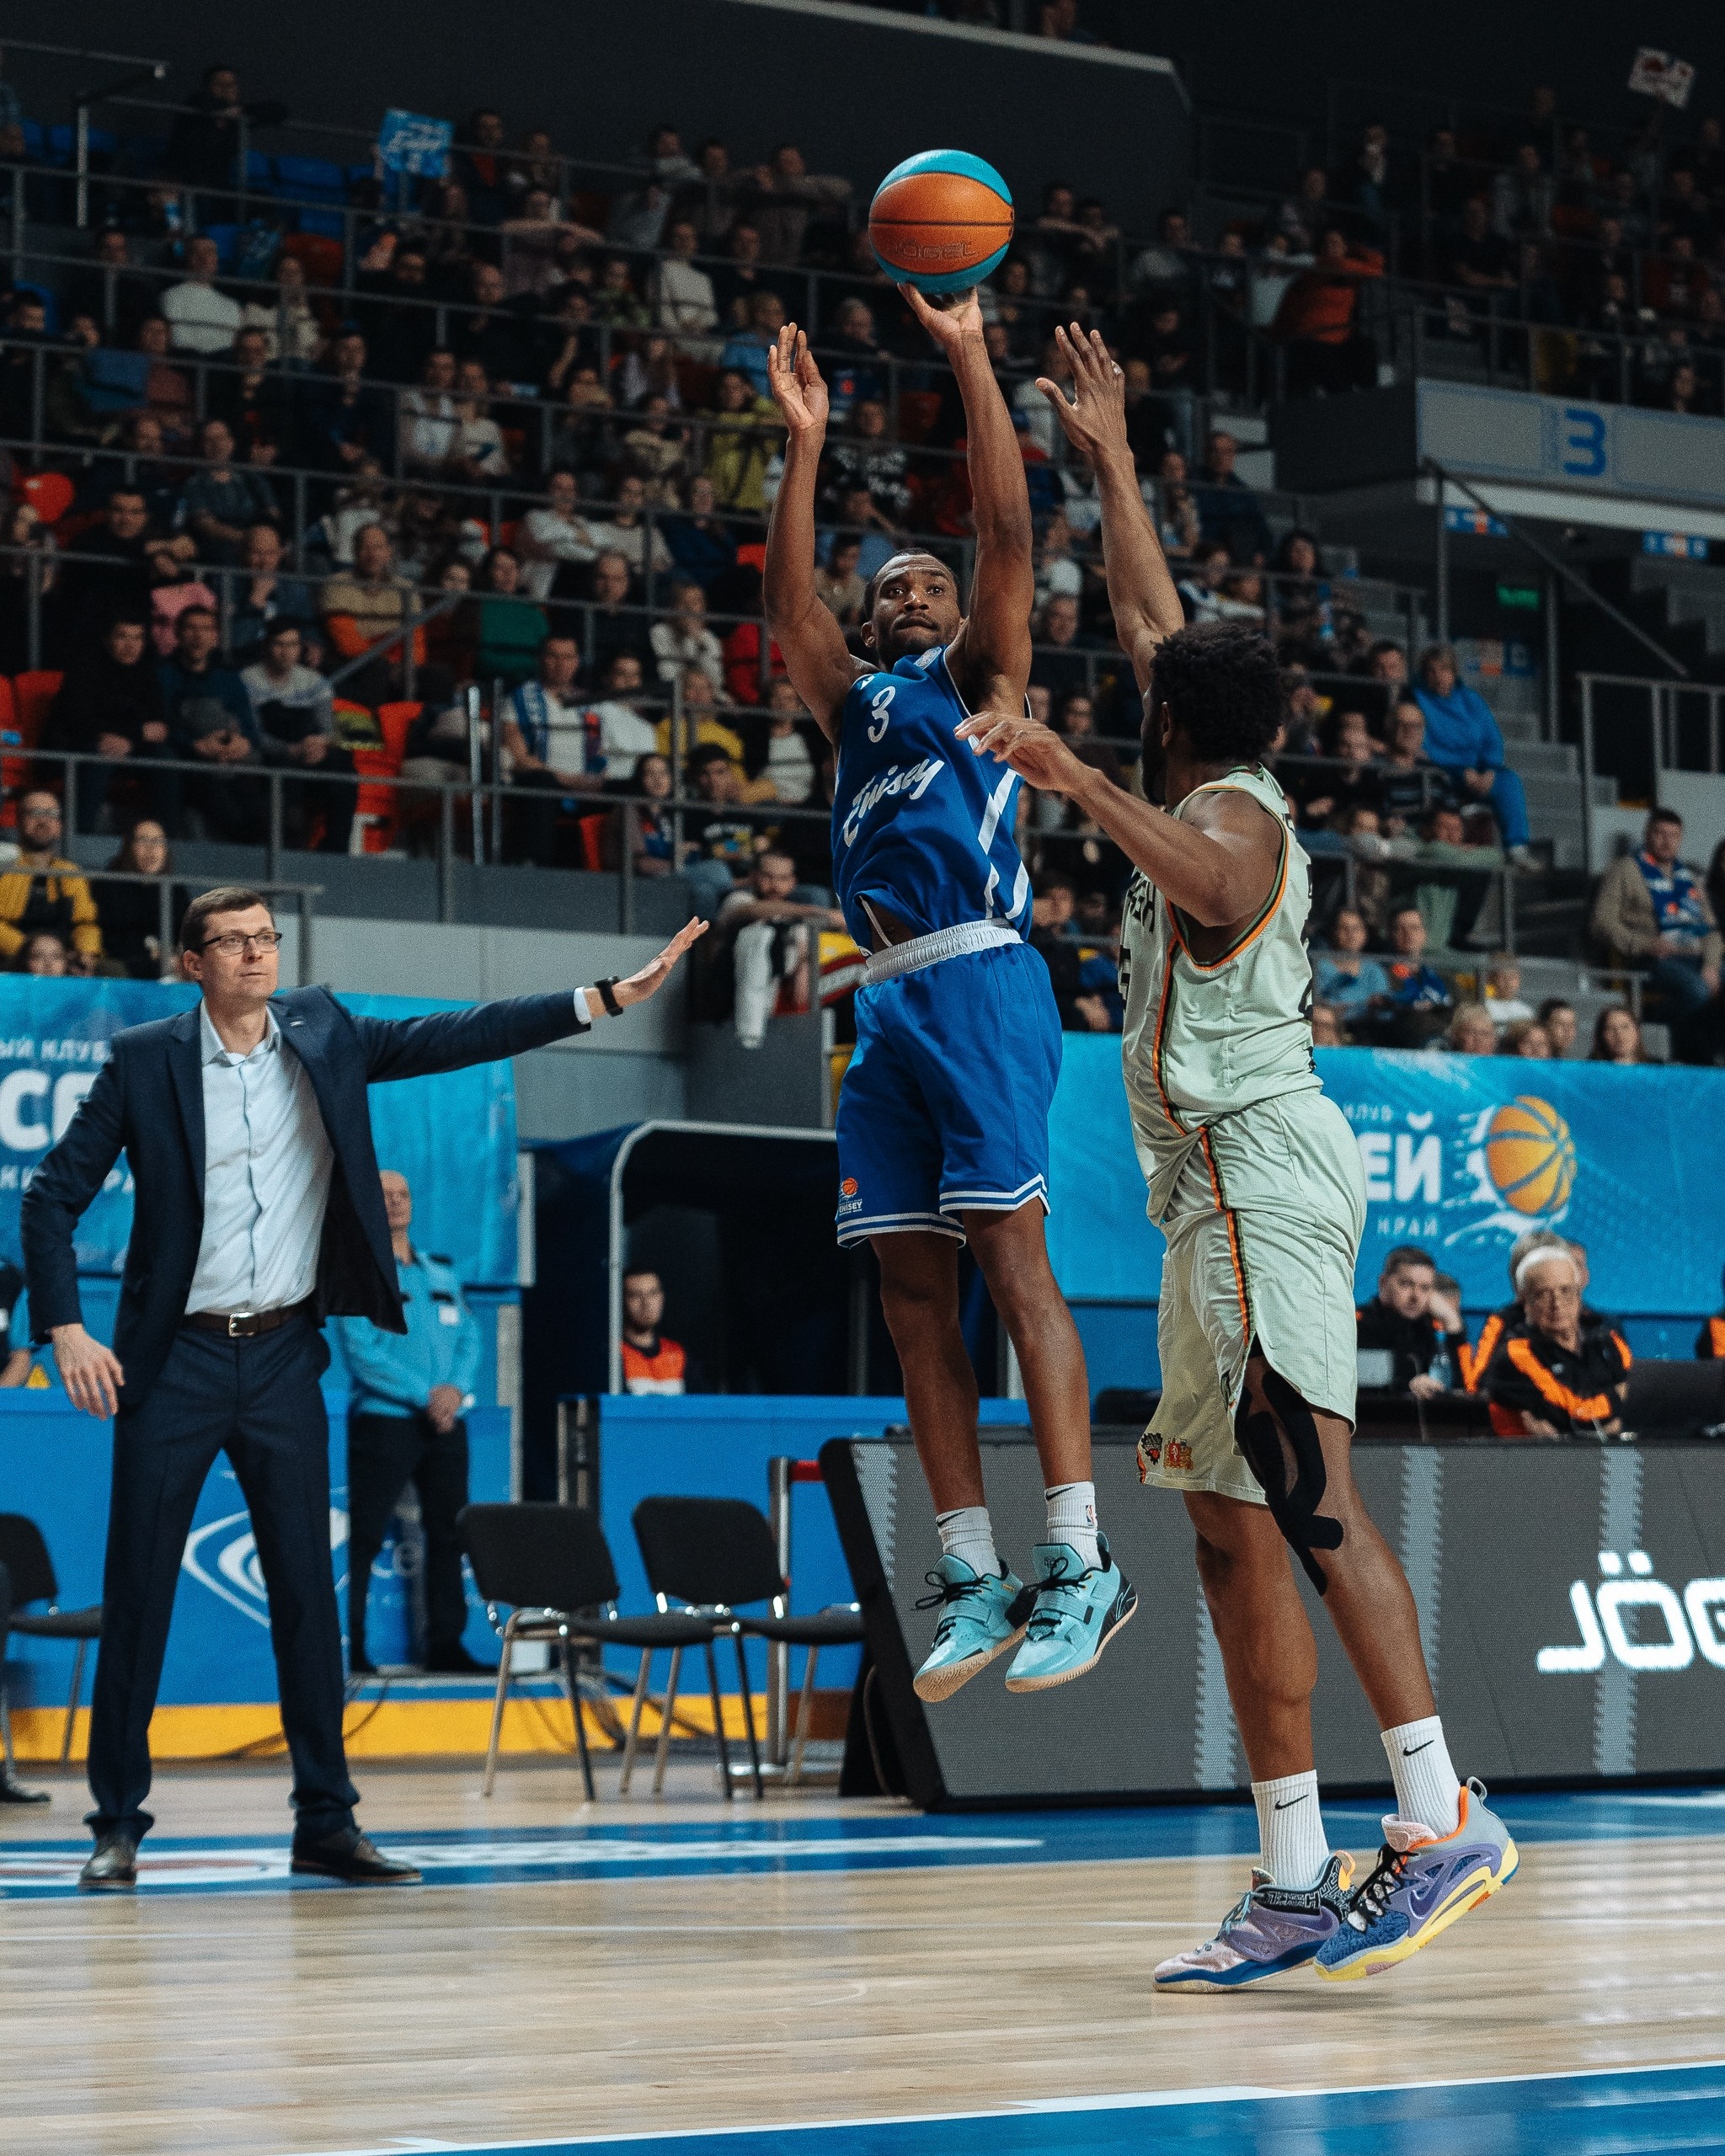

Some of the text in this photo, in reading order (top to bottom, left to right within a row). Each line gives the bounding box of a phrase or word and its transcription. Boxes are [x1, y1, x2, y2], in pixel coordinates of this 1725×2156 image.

[1563, 408, 1606, 478] 3
[868, 686, 895, 743] 3
[839, 1201, 862, 1213] ENISEY
